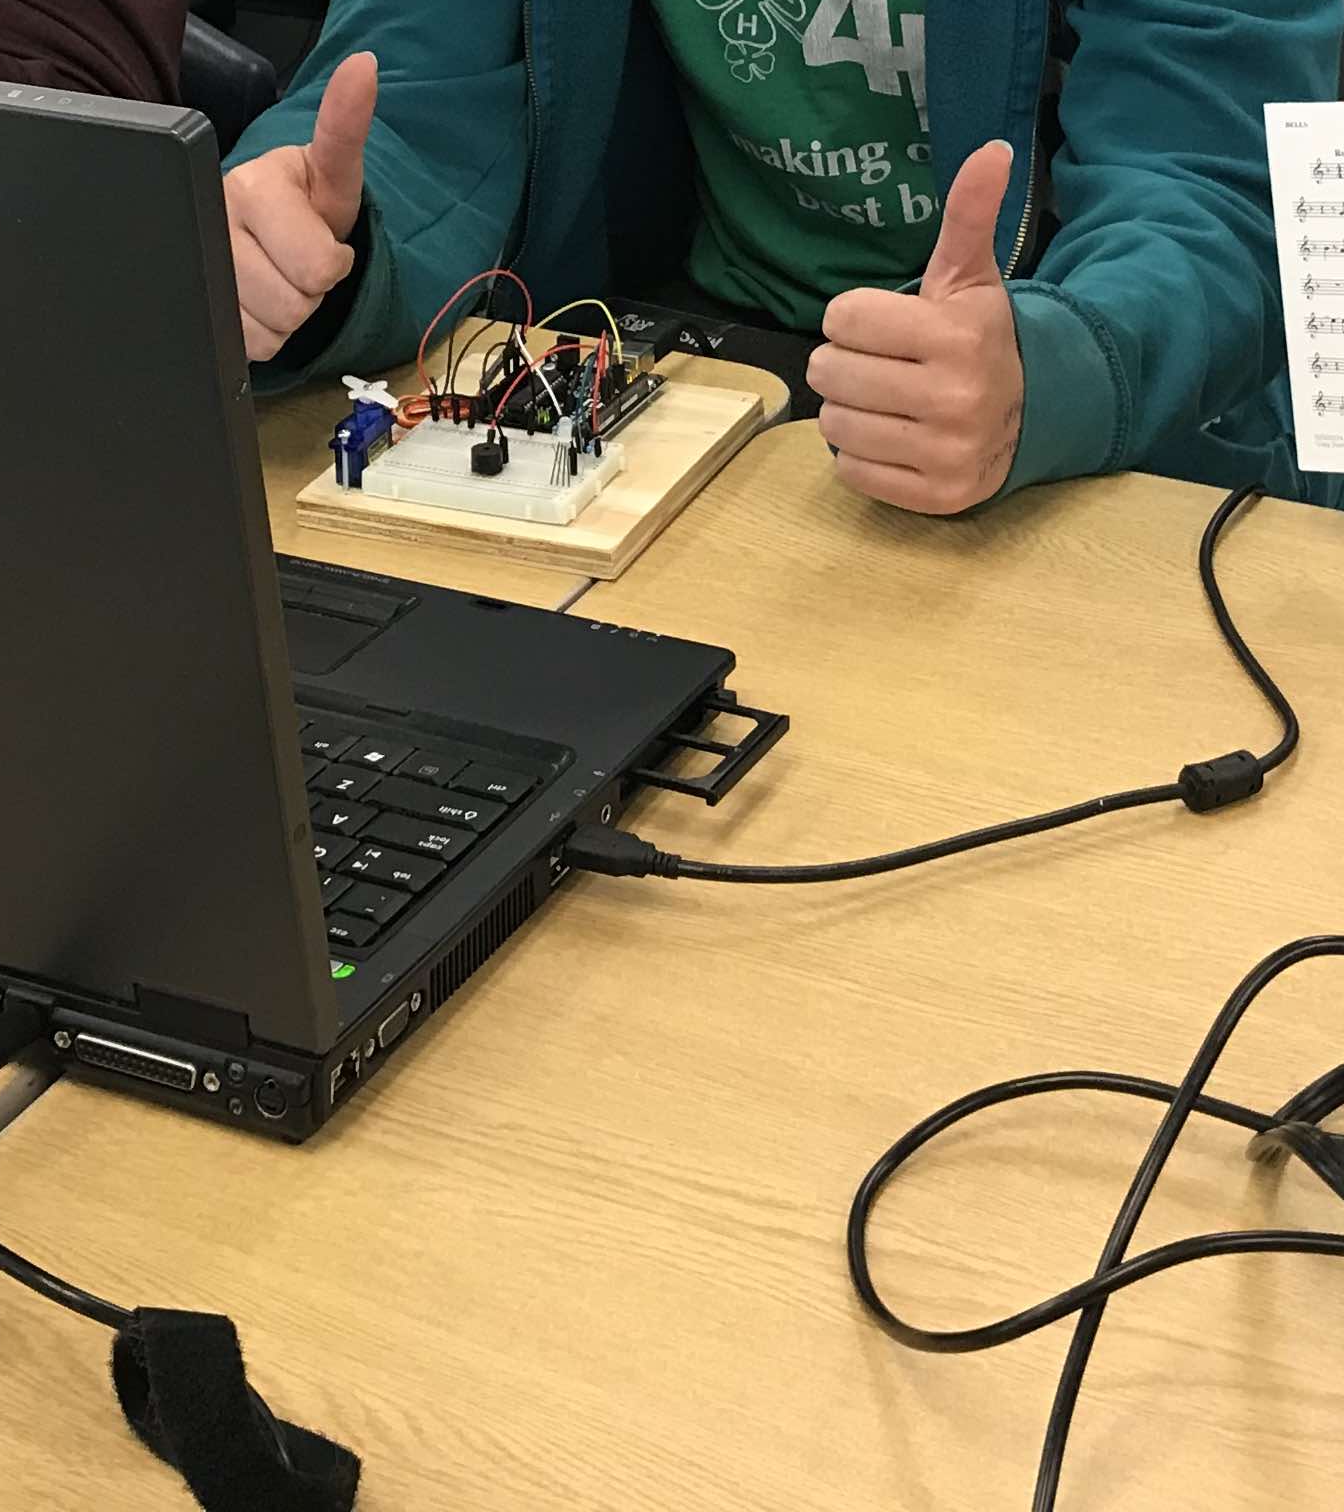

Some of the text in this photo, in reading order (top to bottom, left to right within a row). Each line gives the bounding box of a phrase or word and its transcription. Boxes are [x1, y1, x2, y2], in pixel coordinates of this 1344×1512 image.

[336, 779, 354, 790] Z
[438, 805, 463, 816] shift
[332, 814, 349, 825] A
